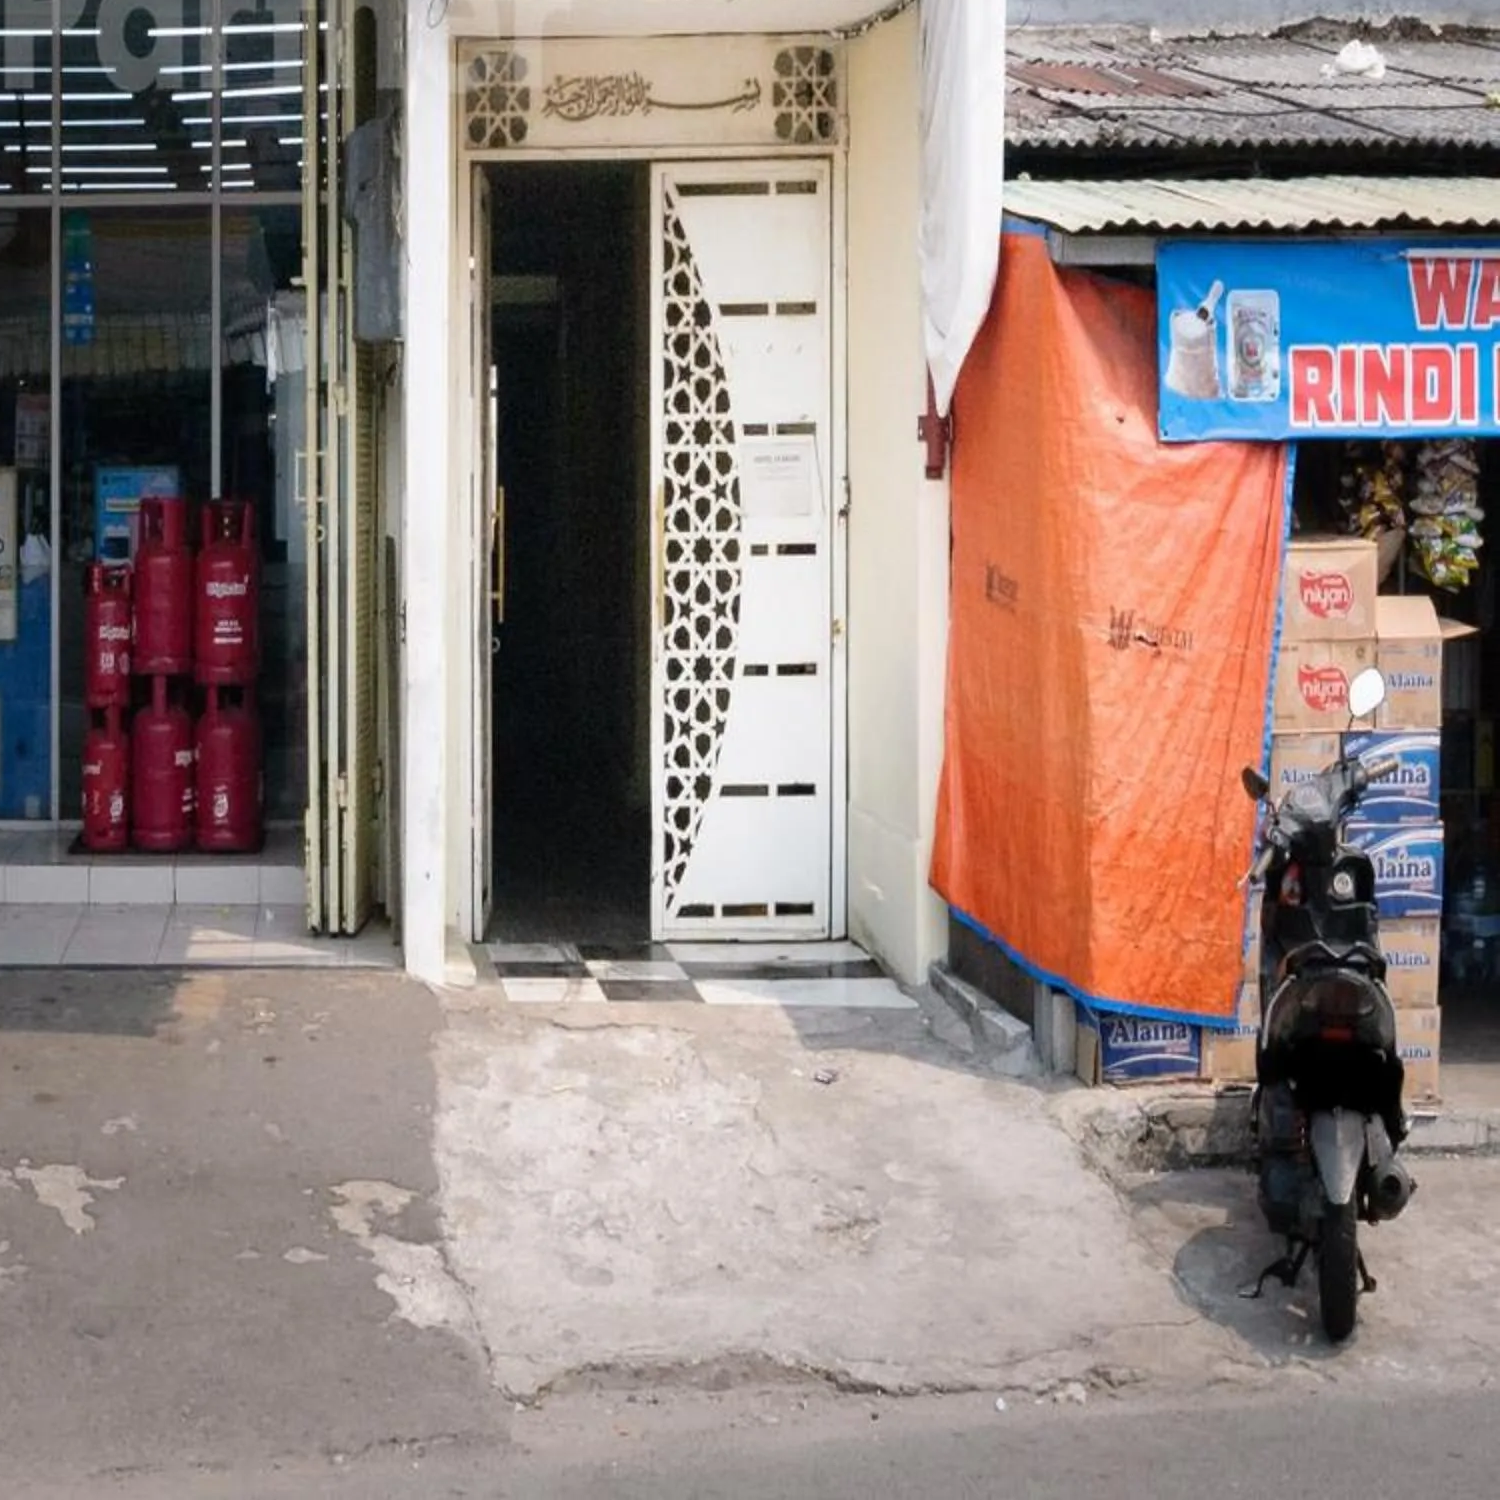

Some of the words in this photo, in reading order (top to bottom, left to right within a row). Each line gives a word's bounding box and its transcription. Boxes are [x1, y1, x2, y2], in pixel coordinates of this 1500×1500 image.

[1288, 343, 1479, 428] RINDI
[1386, 673, 1434, 689] Alaina
[1377, 853, 1432, 879] laina
[1111, 1019, 1188, 1045] Alaina
